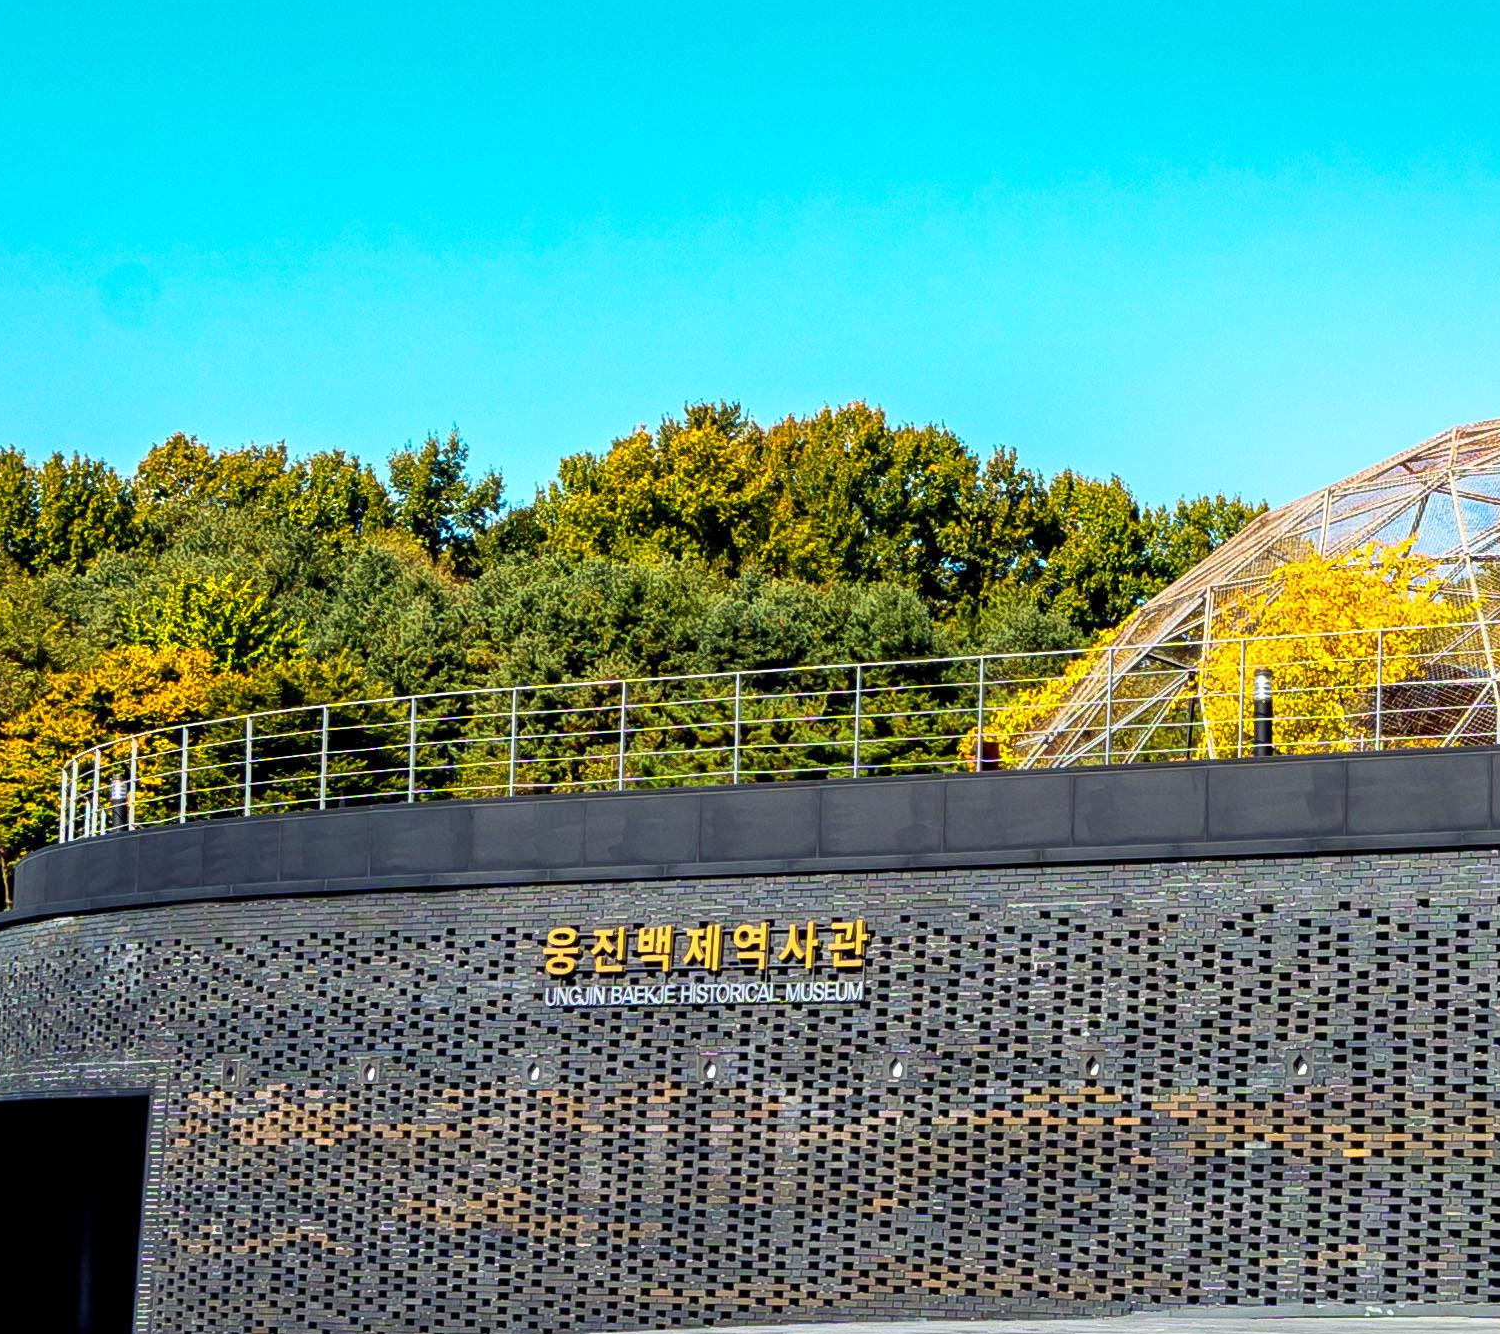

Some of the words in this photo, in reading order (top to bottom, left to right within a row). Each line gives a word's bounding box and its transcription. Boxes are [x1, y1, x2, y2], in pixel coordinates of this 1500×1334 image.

[542, 918, 870, 976] 웅진백제역사관
[545, 986, 607, 1007] UNGJIN
[611, 984, 678, 1005] BAEKJE
[681, 981, 777, 1004] HISTORICAL
[785, 981, 864, 1002] MUSEUM
